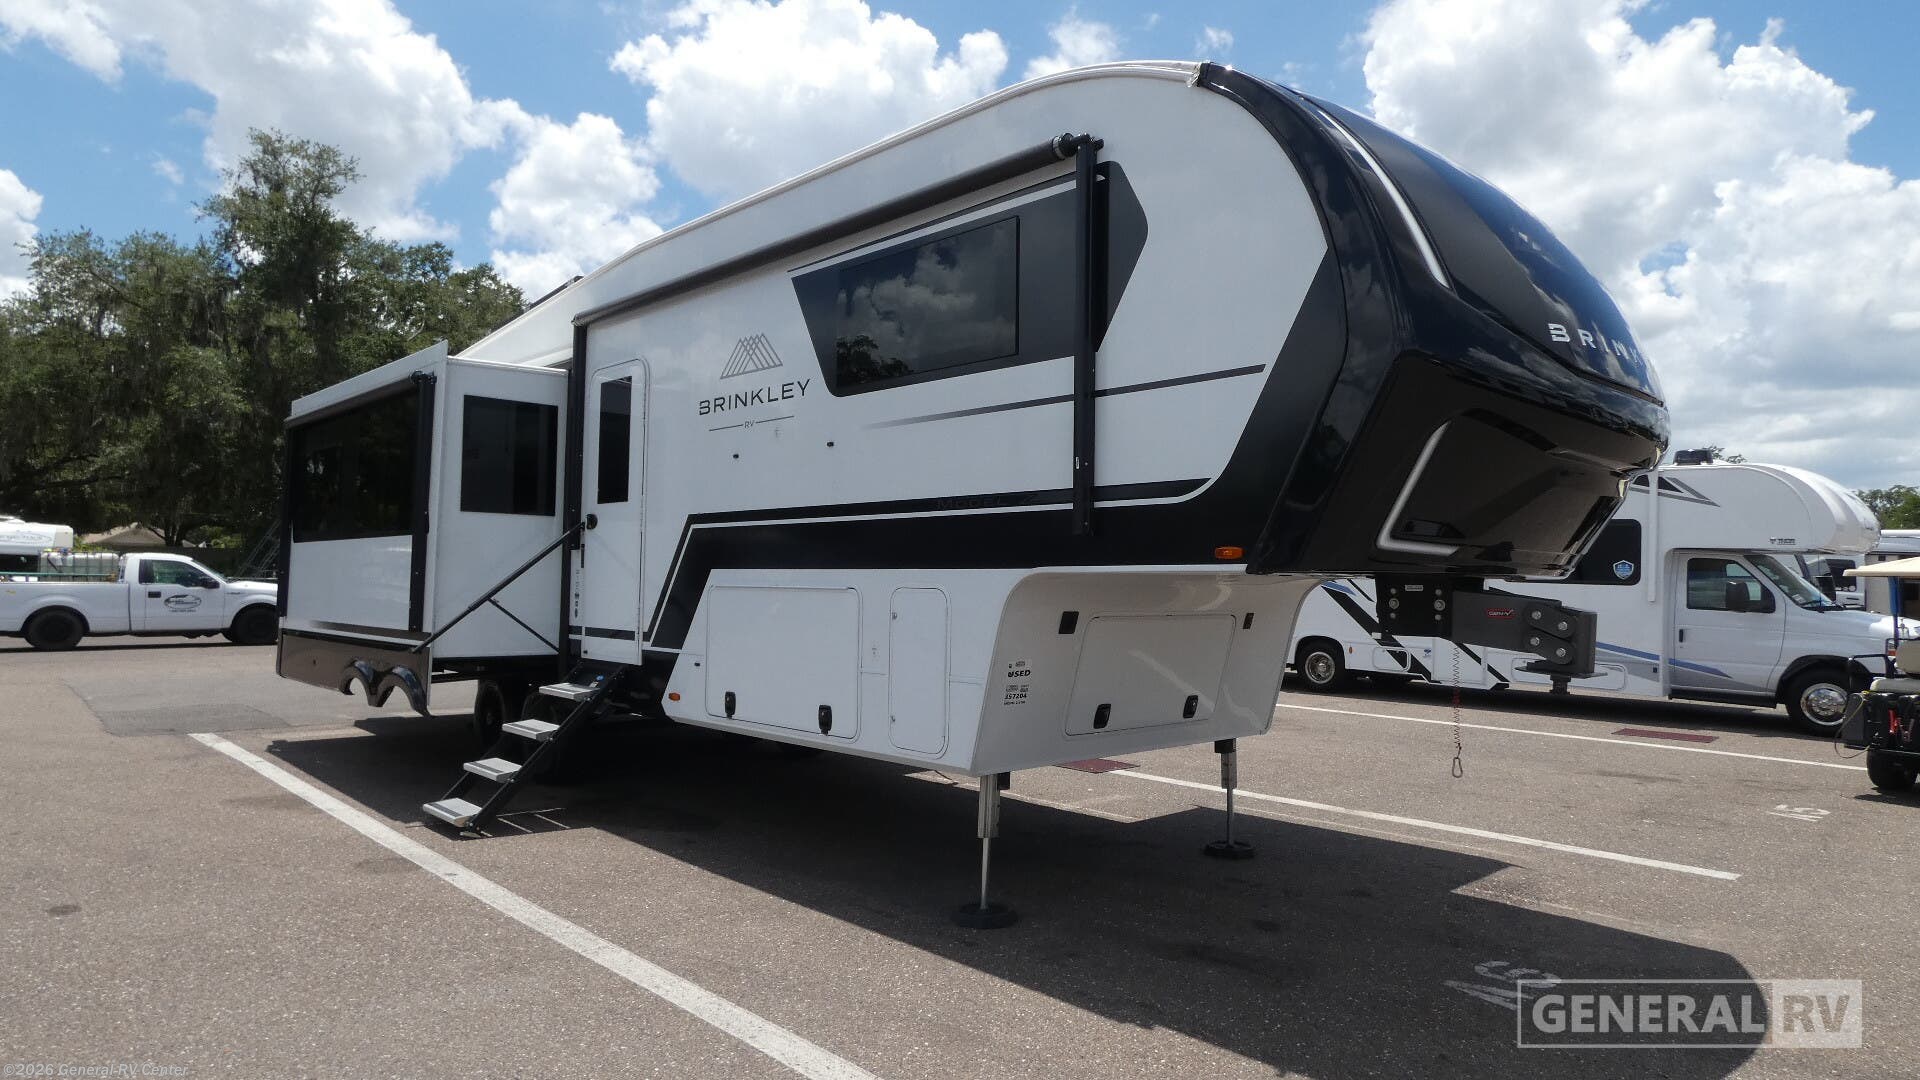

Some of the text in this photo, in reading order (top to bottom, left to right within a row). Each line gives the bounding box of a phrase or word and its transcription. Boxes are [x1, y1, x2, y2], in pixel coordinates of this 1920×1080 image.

[699, 379, 811, 416] BRINKLEY
[744, 420, 755, 429] RV
[937, 495, 1007, 510] MODEL
[1007, 669, 1031, 678] USED
